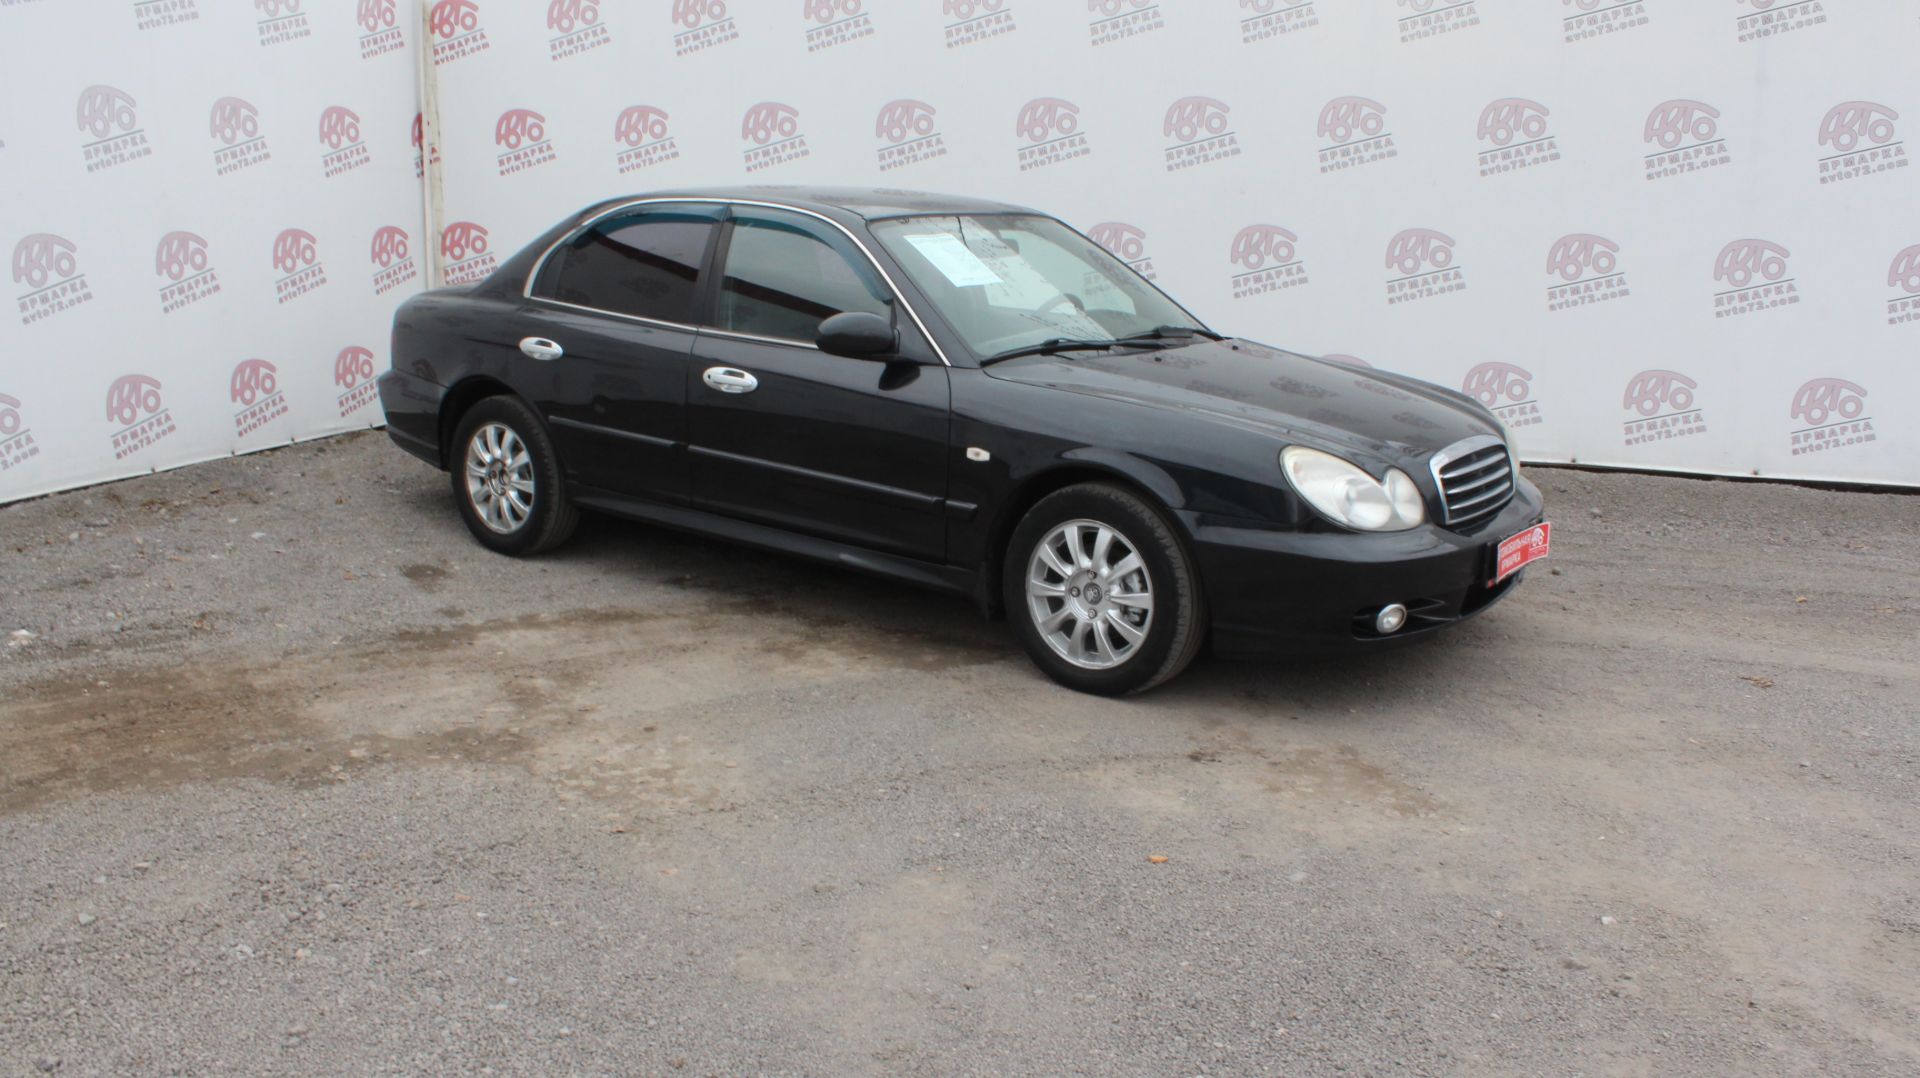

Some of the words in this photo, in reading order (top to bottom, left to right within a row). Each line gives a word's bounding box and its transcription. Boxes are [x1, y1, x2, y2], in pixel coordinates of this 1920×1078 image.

[134, 0, 195, 18] ЯРМАРКА
[1241, 7, 1315, 34] ЯРМАРКА
[1399, 6, 1476, 32] ЯРМАРКА
[1564, 4, 1645, 32] ЯРМАРКА
[1737, 2, 1822, 32] ЯРМАРКА
[258, 17, 307, 35] ЯРМАРКА
[675, 22, 735, 47] ЯРМАРКА
[806, 17, 871, 43] ЯРМАРКА
[945, 13, 1012, 39] ЯРМАРКА
[1090, 9, 1160, 36] ЯРМАРКА
[360, 30, 402, 49] ЯРМАРКА
[433, 32, 486, 56] ЯРМАРКА
[550, 27, 608, 52] ЯРМАРКА
[84, 135, 148, 160] ЯРМАРКА
[215, 141, 267, 165] ЯРМАРКА
[324, 146, 367, 168] ЯРМАРКА
[498, 144, 552, 167] ЯРМАРКА
[618, 141, 676, 164] ЯРМАРКА
[745, 139, 806, 163] ЯРМАРКА
[878, 137, 943, 162] ЯРМАРКА
[1018, 137, 1087, 162] ЯРМАРКА
[1166, 136, 1237, 162] ЯРМАРКА
[1319, 138, 1394, 163] ЯРМАРКА
[1479, 141, 1557, 166] ЯРМАРКА
[1645, 143, 1727, 170] ЯРМАРКА
[1819, 146, 1905, 173] ЯРМАРКА
[374, 261, 414, 285] ЯРМАРКА
[444, 256, 496, 277] ЯРМАРКА
[1232, 265, 1304, 288] ЯРМАРКА
[161, 273, 217, 303] ЯРМАРКА
[277, 267, 324, 294] ЯРМАРКА
[1387, 271, 1462, 294] ЯРМАРКА
[1548, 277, 1626, 301] ЯРМАРКА
[19, 279, 88, 313] ЯРМАРКА
[1714, 283, 1797, 307] ЯРМАРКА
[236, 395, 285, 427] ЯРМАРКА
[113, 413, 172, 448] ЯРМАРКА
[1624, 413, 1704, 435] ЯРМАРКА
[1791, 422, 1873, 445] ЯРМАРКА
